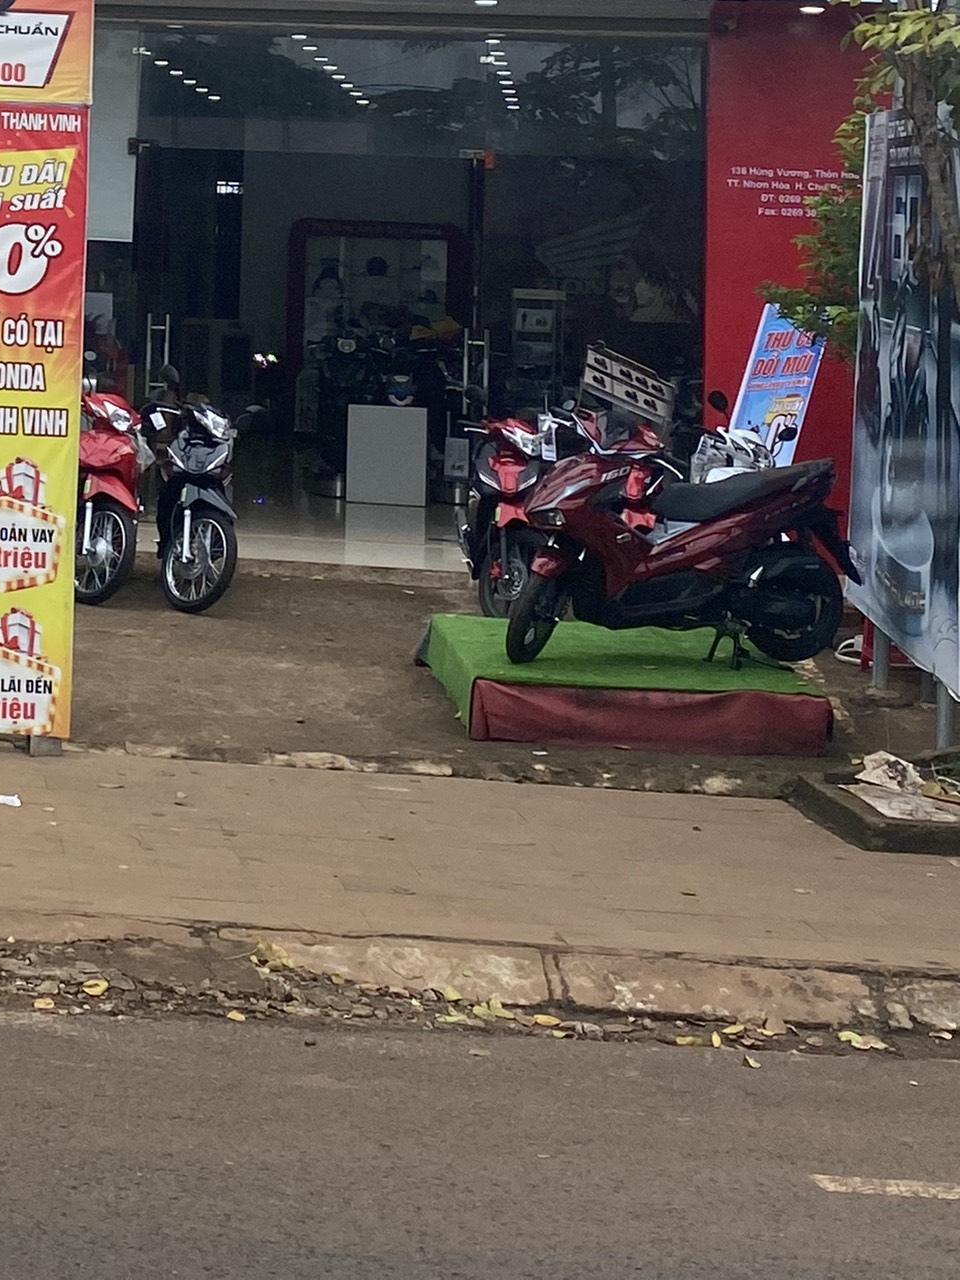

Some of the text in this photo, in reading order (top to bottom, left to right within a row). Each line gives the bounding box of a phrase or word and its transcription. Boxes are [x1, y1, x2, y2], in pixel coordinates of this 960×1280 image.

[1, 109, 47, 130] THÀNH
[49, 113, 81, 132] VINH
[20, 159, 66, 185] ĐÃI
[9, 184, 66, 211] suất
[2, 314, 29, 346] CÓ
[33, 320, 63, 352] TẠI
[23, 408, 68, 437] VINH
[32, 528, 55, 543] VAY
[1, 675, 21, 693] LÃI
[26, 675, 53, 694] ĐẾN
